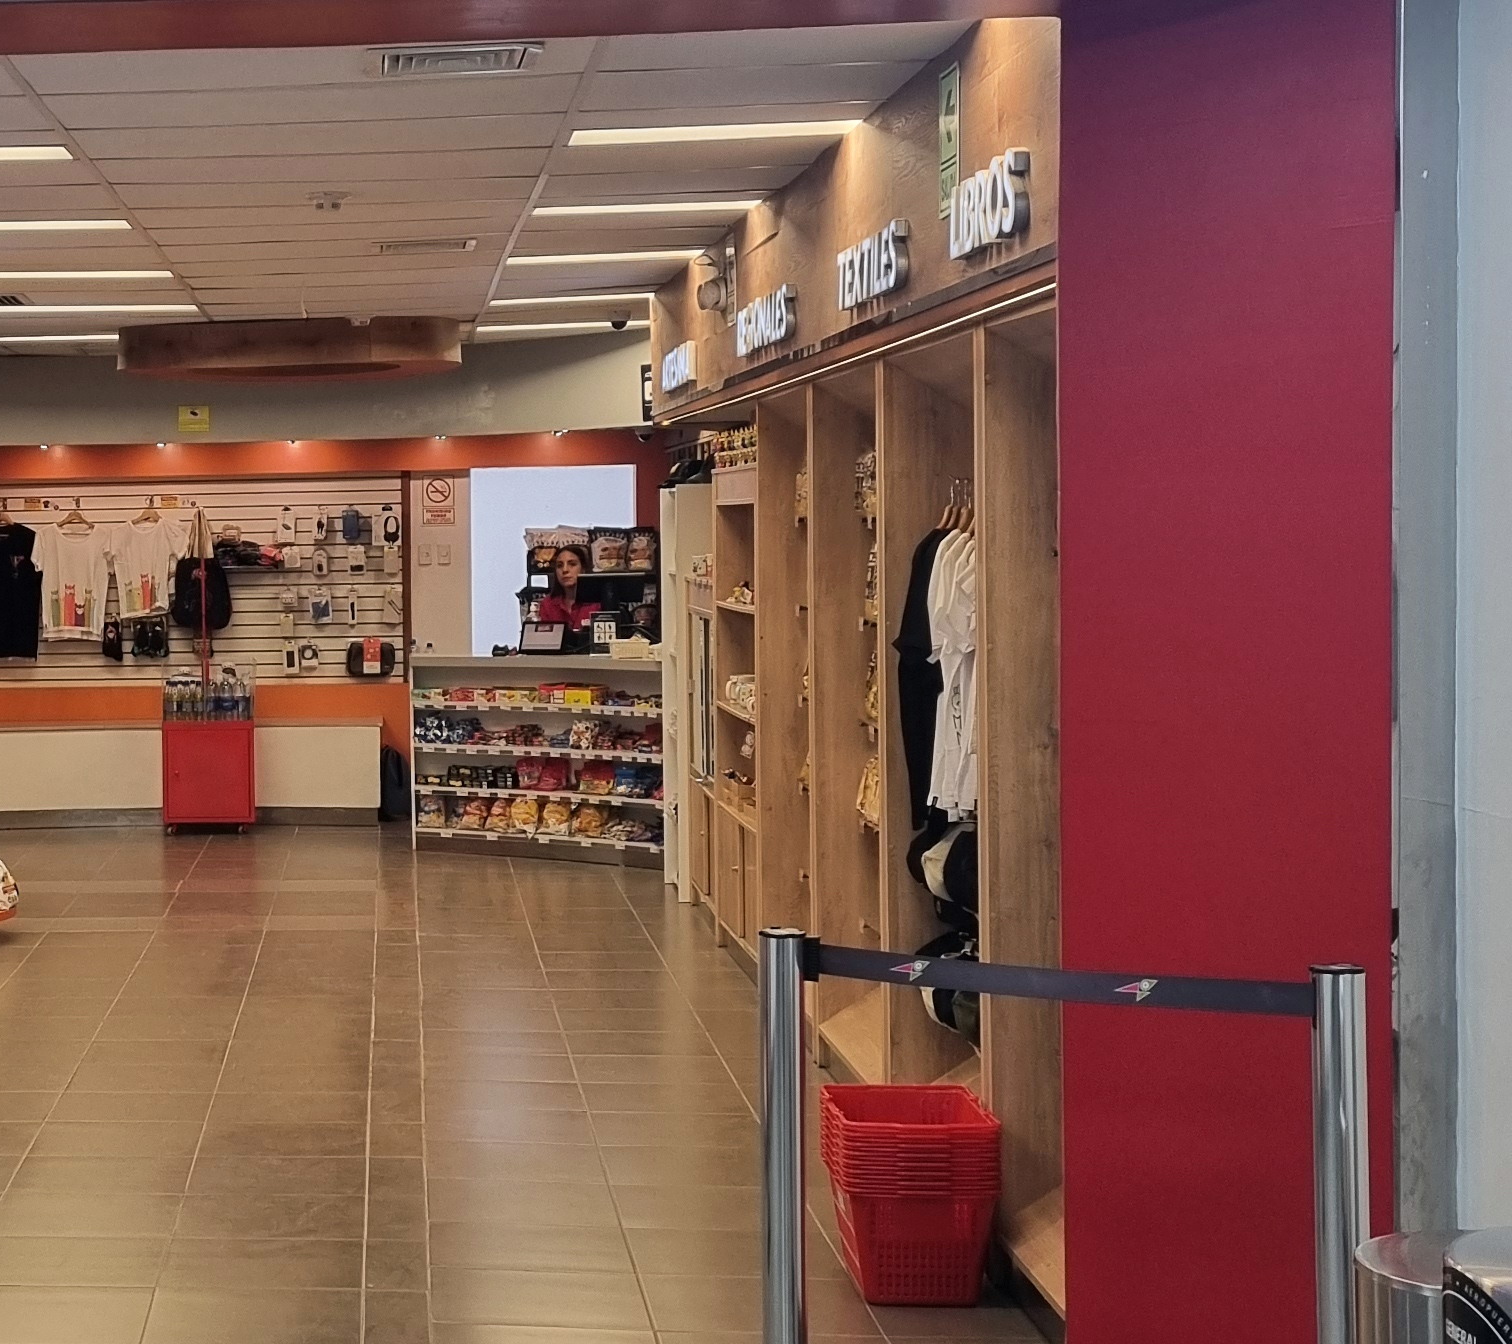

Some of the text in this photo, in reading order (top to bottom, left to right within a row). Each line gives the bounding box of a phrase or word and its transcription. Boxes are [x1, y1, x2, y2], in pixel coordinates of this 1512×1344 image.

[950, 147, 1026, 260] LIBROS
[838, 219, 903, 311] TEXTILES
[1464, 1284, 1512, 1341] AEROPUER
